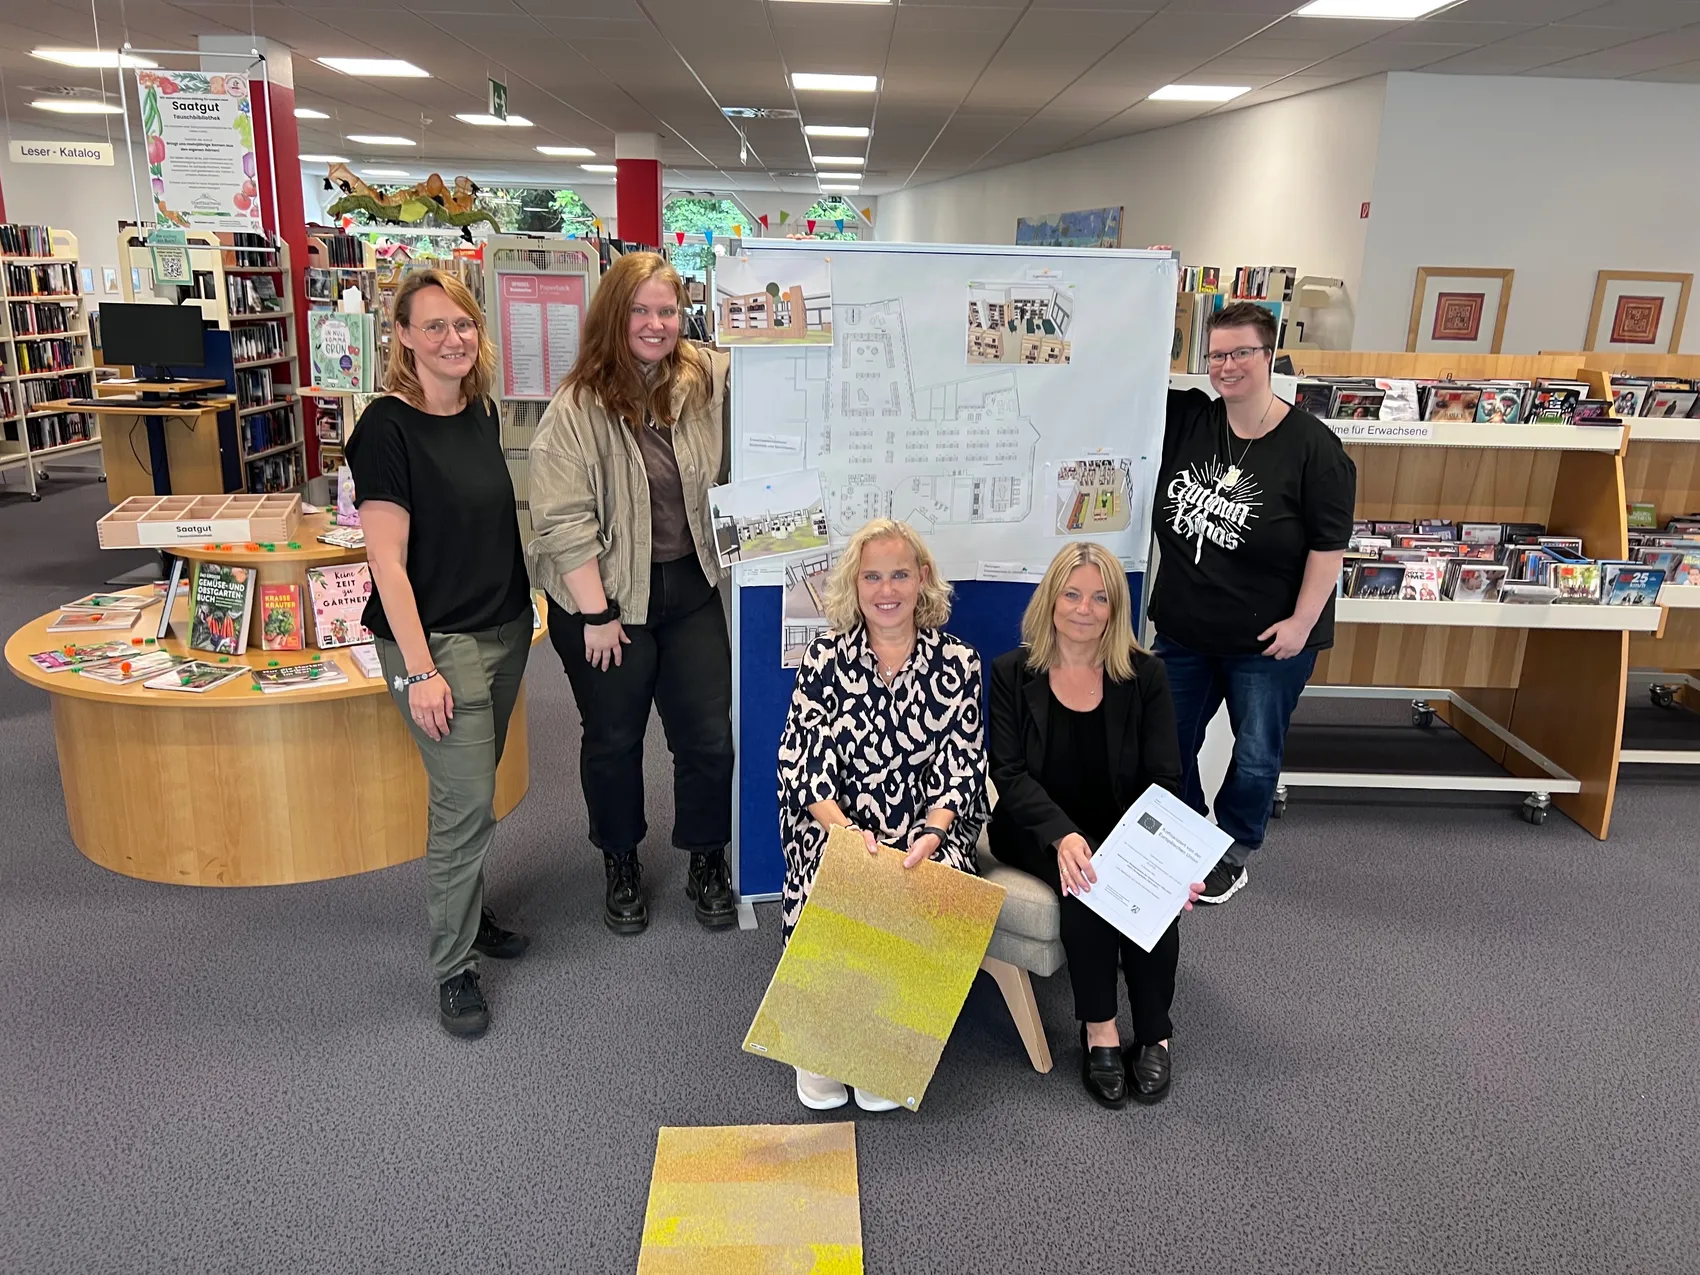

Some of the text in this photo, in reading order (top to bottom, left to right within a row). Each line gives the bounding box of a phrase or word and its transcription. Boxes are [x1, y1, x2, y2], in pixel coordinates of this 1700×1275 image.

[172, 101, 220, 114] Saatgut
[20, 146, 50, 156] Leser
[60, 147, 100, 160] Katalog
[326, 344, 346, 355] GRÜN
[1328, 424, 1428, 436] ilme für Erwachsene
[334, 572, 355, 580] Keine
[1426, 572, 1434, 580] 2
[1632, 572, 1649, 583] 25
[198, 578, 244, 592] GEMÜSE- UND
[198, 586, 244, 599] OBSTGARTEN-
[196, 594, 216, 603] BUCH
[323, 596, 368, 606] GÄRTNER
